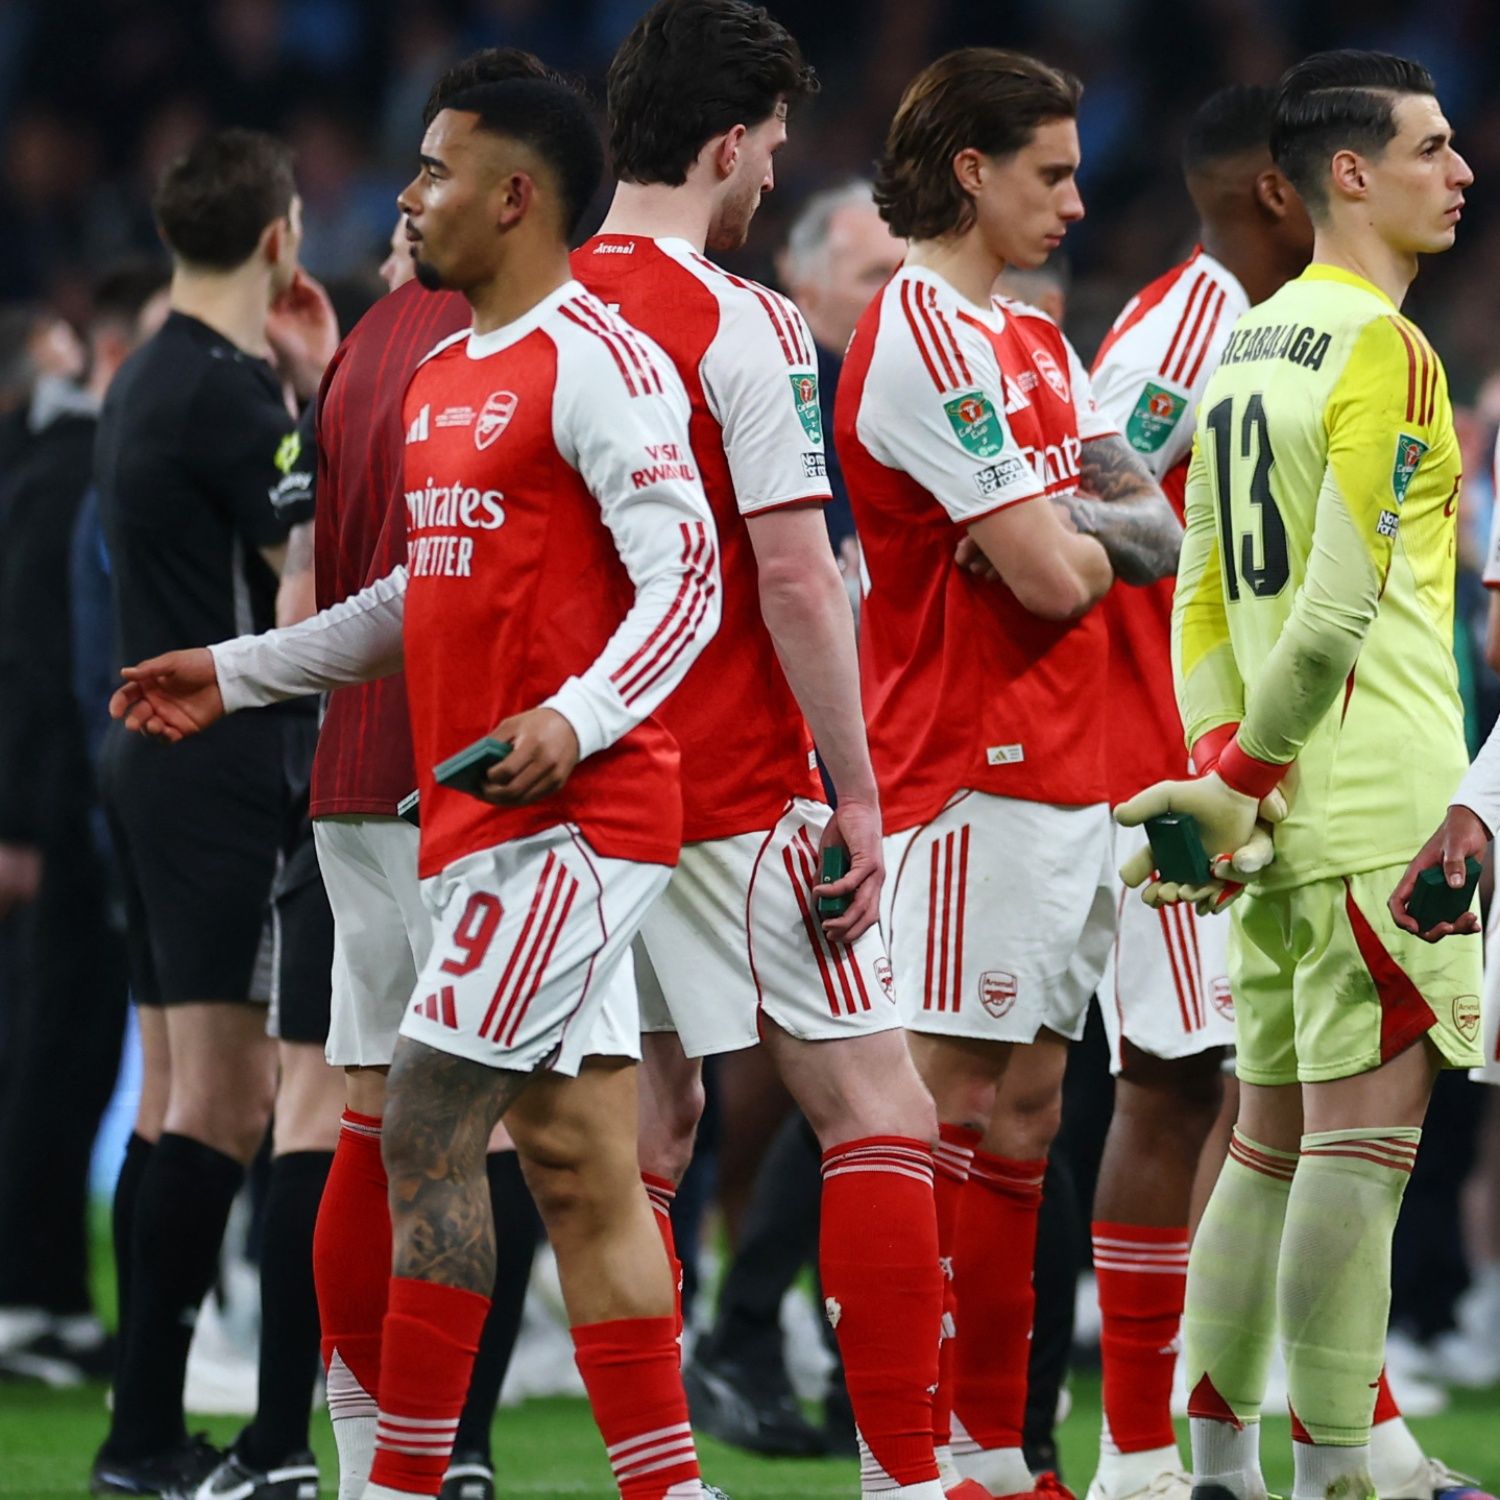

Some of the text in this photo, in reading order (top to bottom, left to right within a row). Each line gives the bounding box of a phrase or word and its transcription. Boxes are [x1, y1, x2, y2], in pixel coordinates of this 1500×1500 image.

[592, 240, 636, 255] Arsenal
[1217, 323, 1333, 372] RIZABALAGA
[975, 468, 995, 484] No
[1207, 394, 1290, 601] 13
[404, 476, 506, 533] mirates
[439, 890, 505, 979] 9
